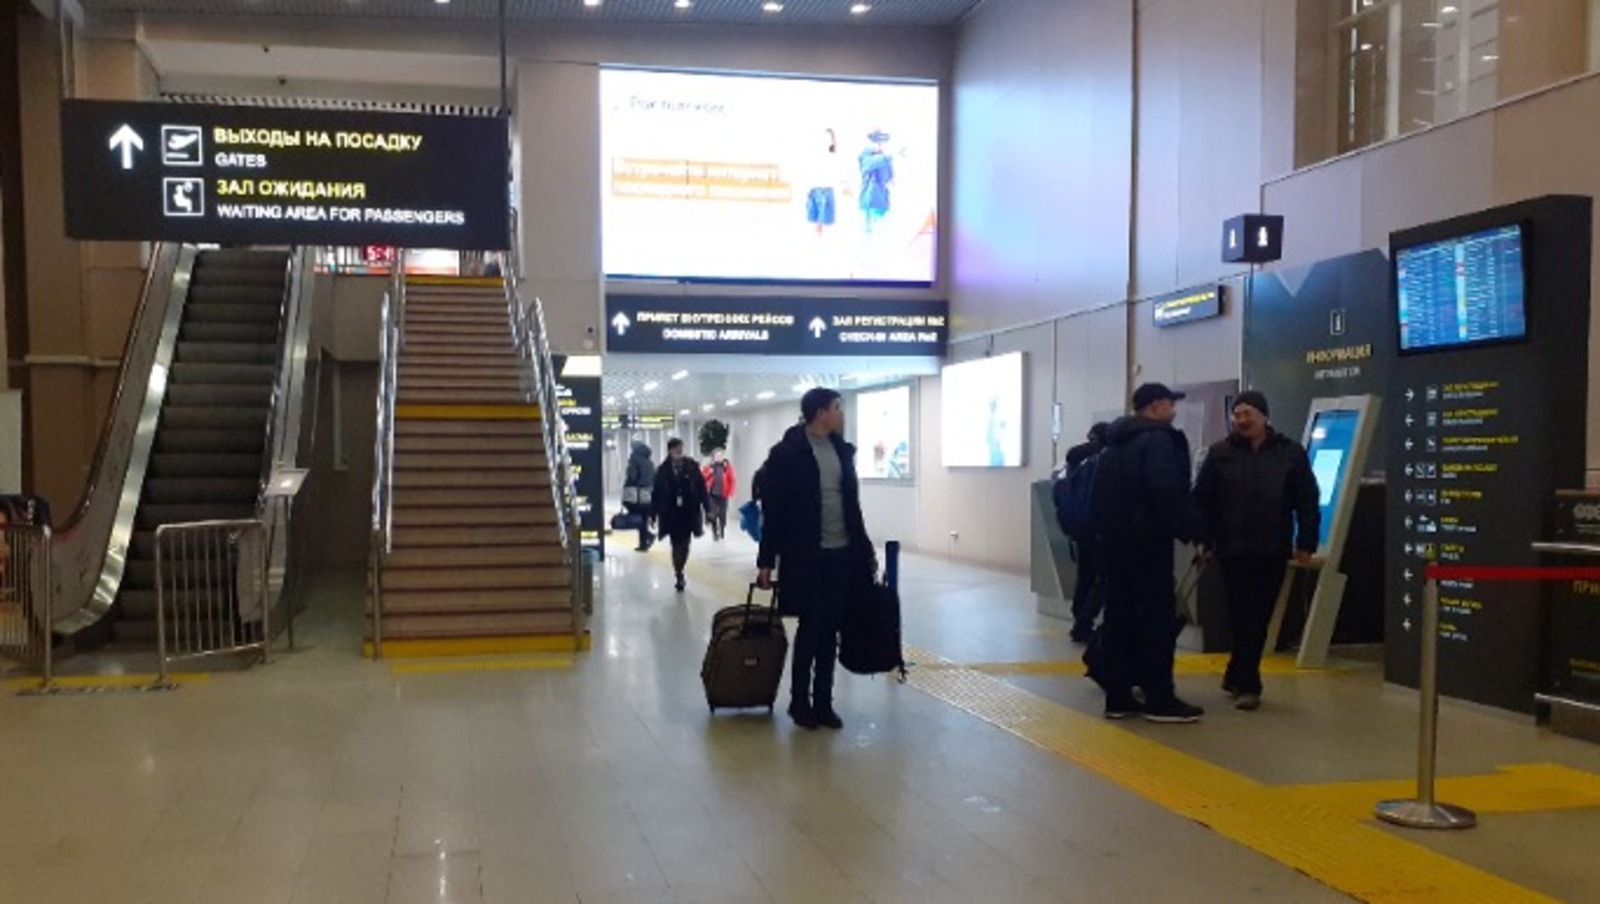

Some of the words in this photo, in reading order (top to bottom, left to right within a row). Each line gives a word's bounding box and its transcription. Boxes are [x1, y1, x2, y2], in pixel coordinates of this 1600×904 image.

[213, 127, 300, 147] ВЫХОДЫ
[305, 130, 332, 148] НА
[335, 132, 423, 152] ПОСАДКУ
[214, 152, 267, 168] GATES
[216, 179, 255, 196] ЗАЛ
[258, 180, 366, 199] ОЖИДАНИЯ
[217, 204, 281, 220] WAITING
[285, 206, 327, 221] AREA
[329, 207, 362, 222] FOR
[364, 208, 466, 225] PASSENGERS
